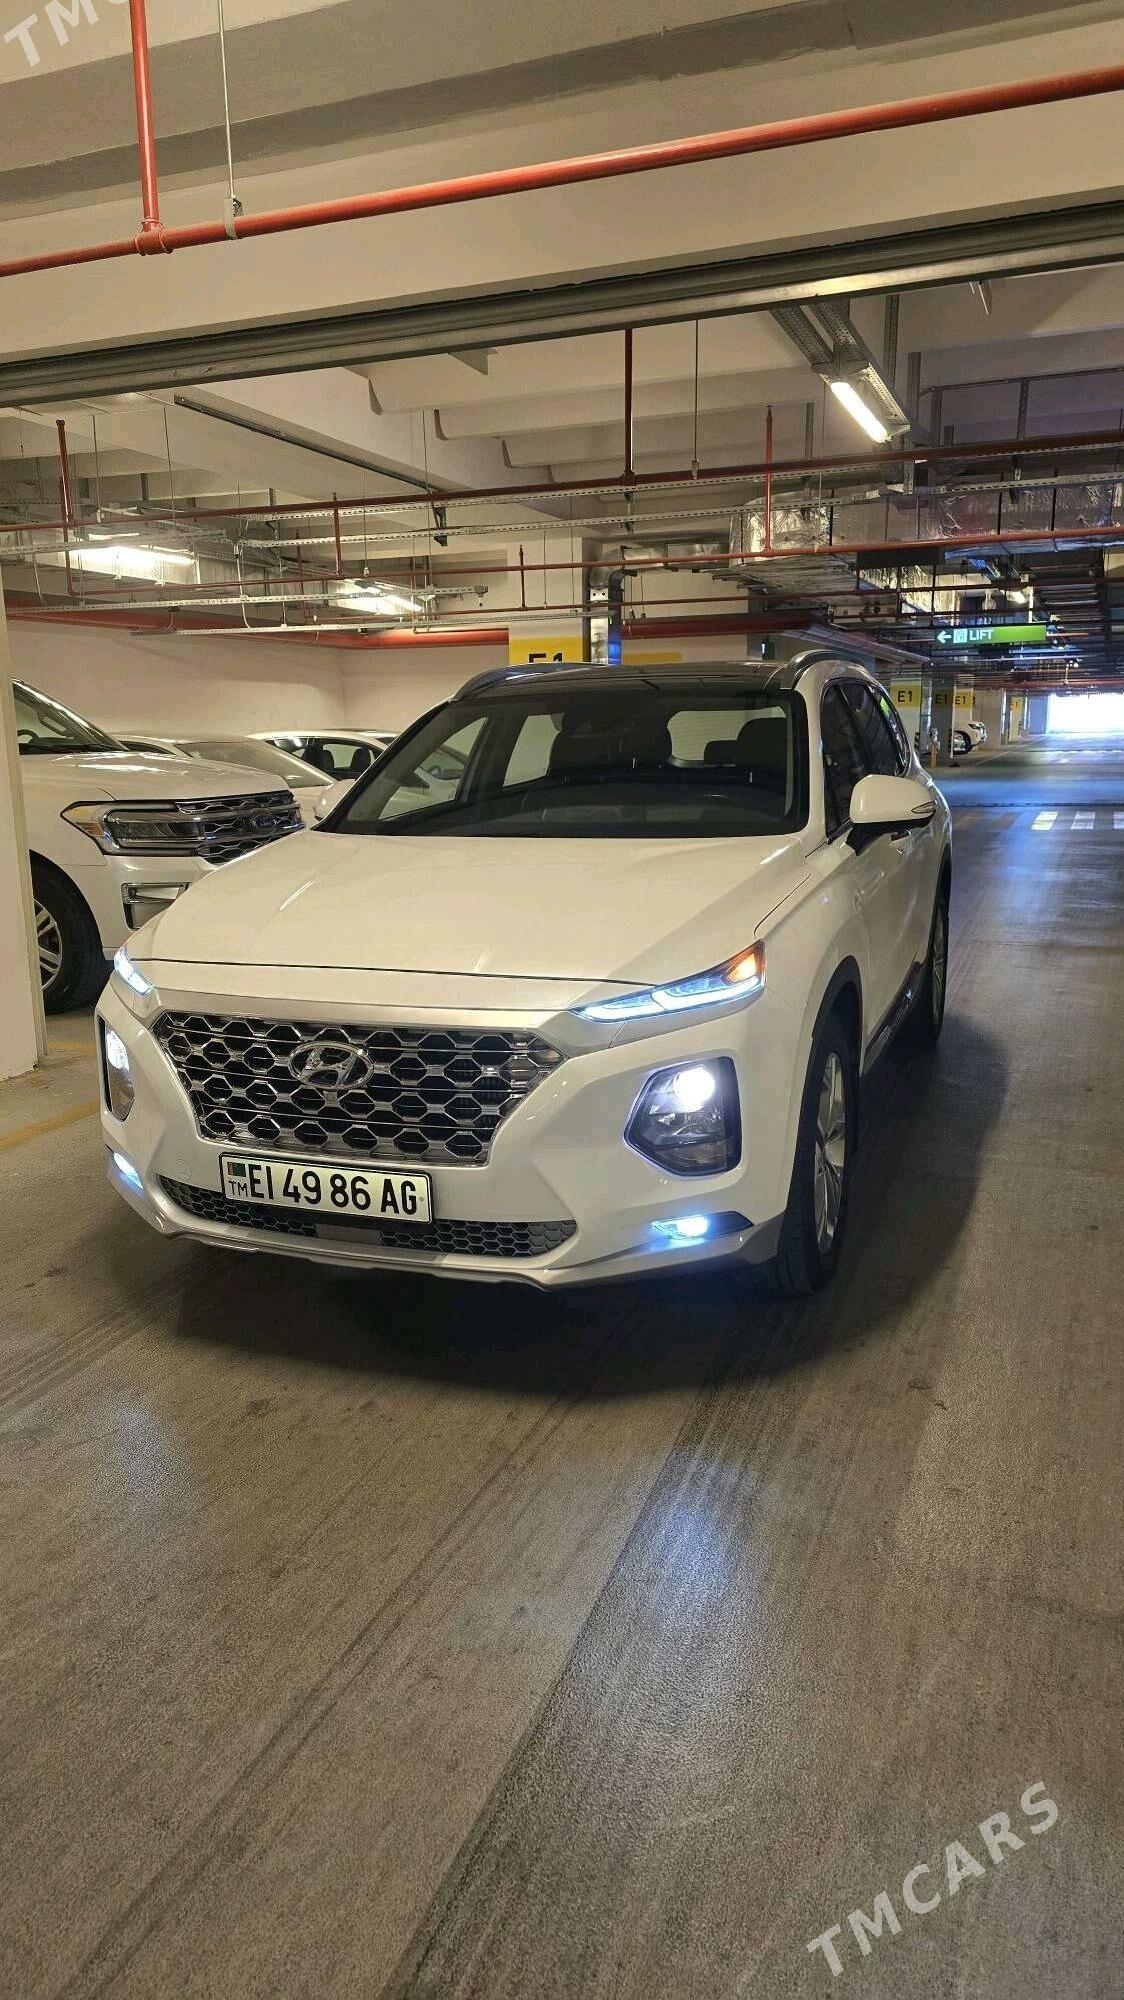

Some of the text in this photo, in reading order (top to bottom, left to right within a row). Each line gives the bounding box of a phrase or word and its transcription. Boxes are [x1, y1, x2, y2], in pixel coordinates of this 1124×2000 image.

[970, 629, 994, 641] LIFT
[898, 691, 912, 702] E1
[935, 694, 947, 704] E1
[955, 696, 966, 705] E1
[229, 1180, 248, 1197] TM
[248, 1164, 417, 1215] EI 49 86 AG
